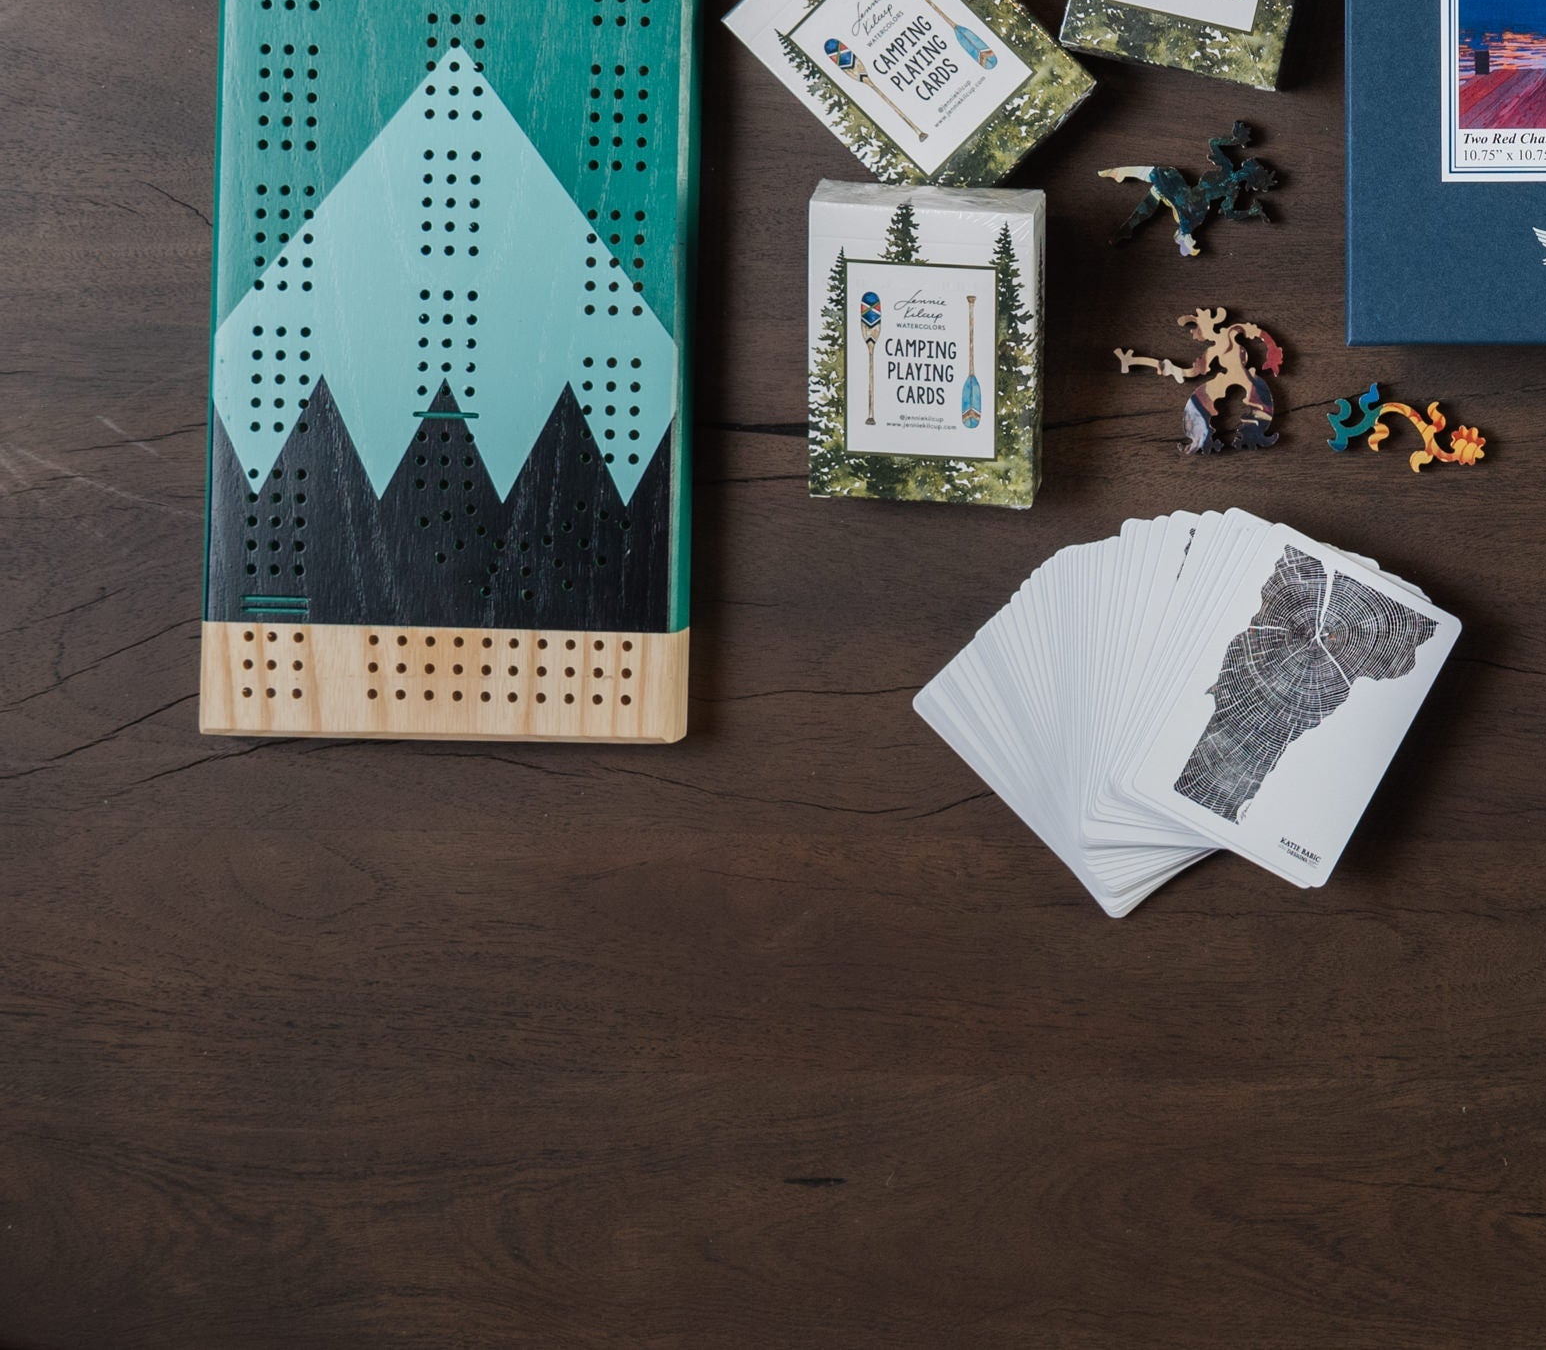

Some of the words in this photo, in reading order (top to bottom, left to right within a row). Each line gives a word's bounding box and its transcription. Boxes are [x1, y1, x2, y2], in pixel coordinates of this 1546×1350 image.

[872, 15, 933, 75] CAMPING
[890, 34, 948, 92] PLAYING
[915, 58, 959, 101] CARDS
[1463, 132, 1489, 144] Two
[1492, 132, 1517, 144] Red
[1506, 152, 1514, 161] x
[896, 322, 947, 331] WATERCOLORS
[885, 337, 957, 360] CAMPING
[887, 361, 955, 383] PLAYING
[896, 385, 946, 406] CARDS
